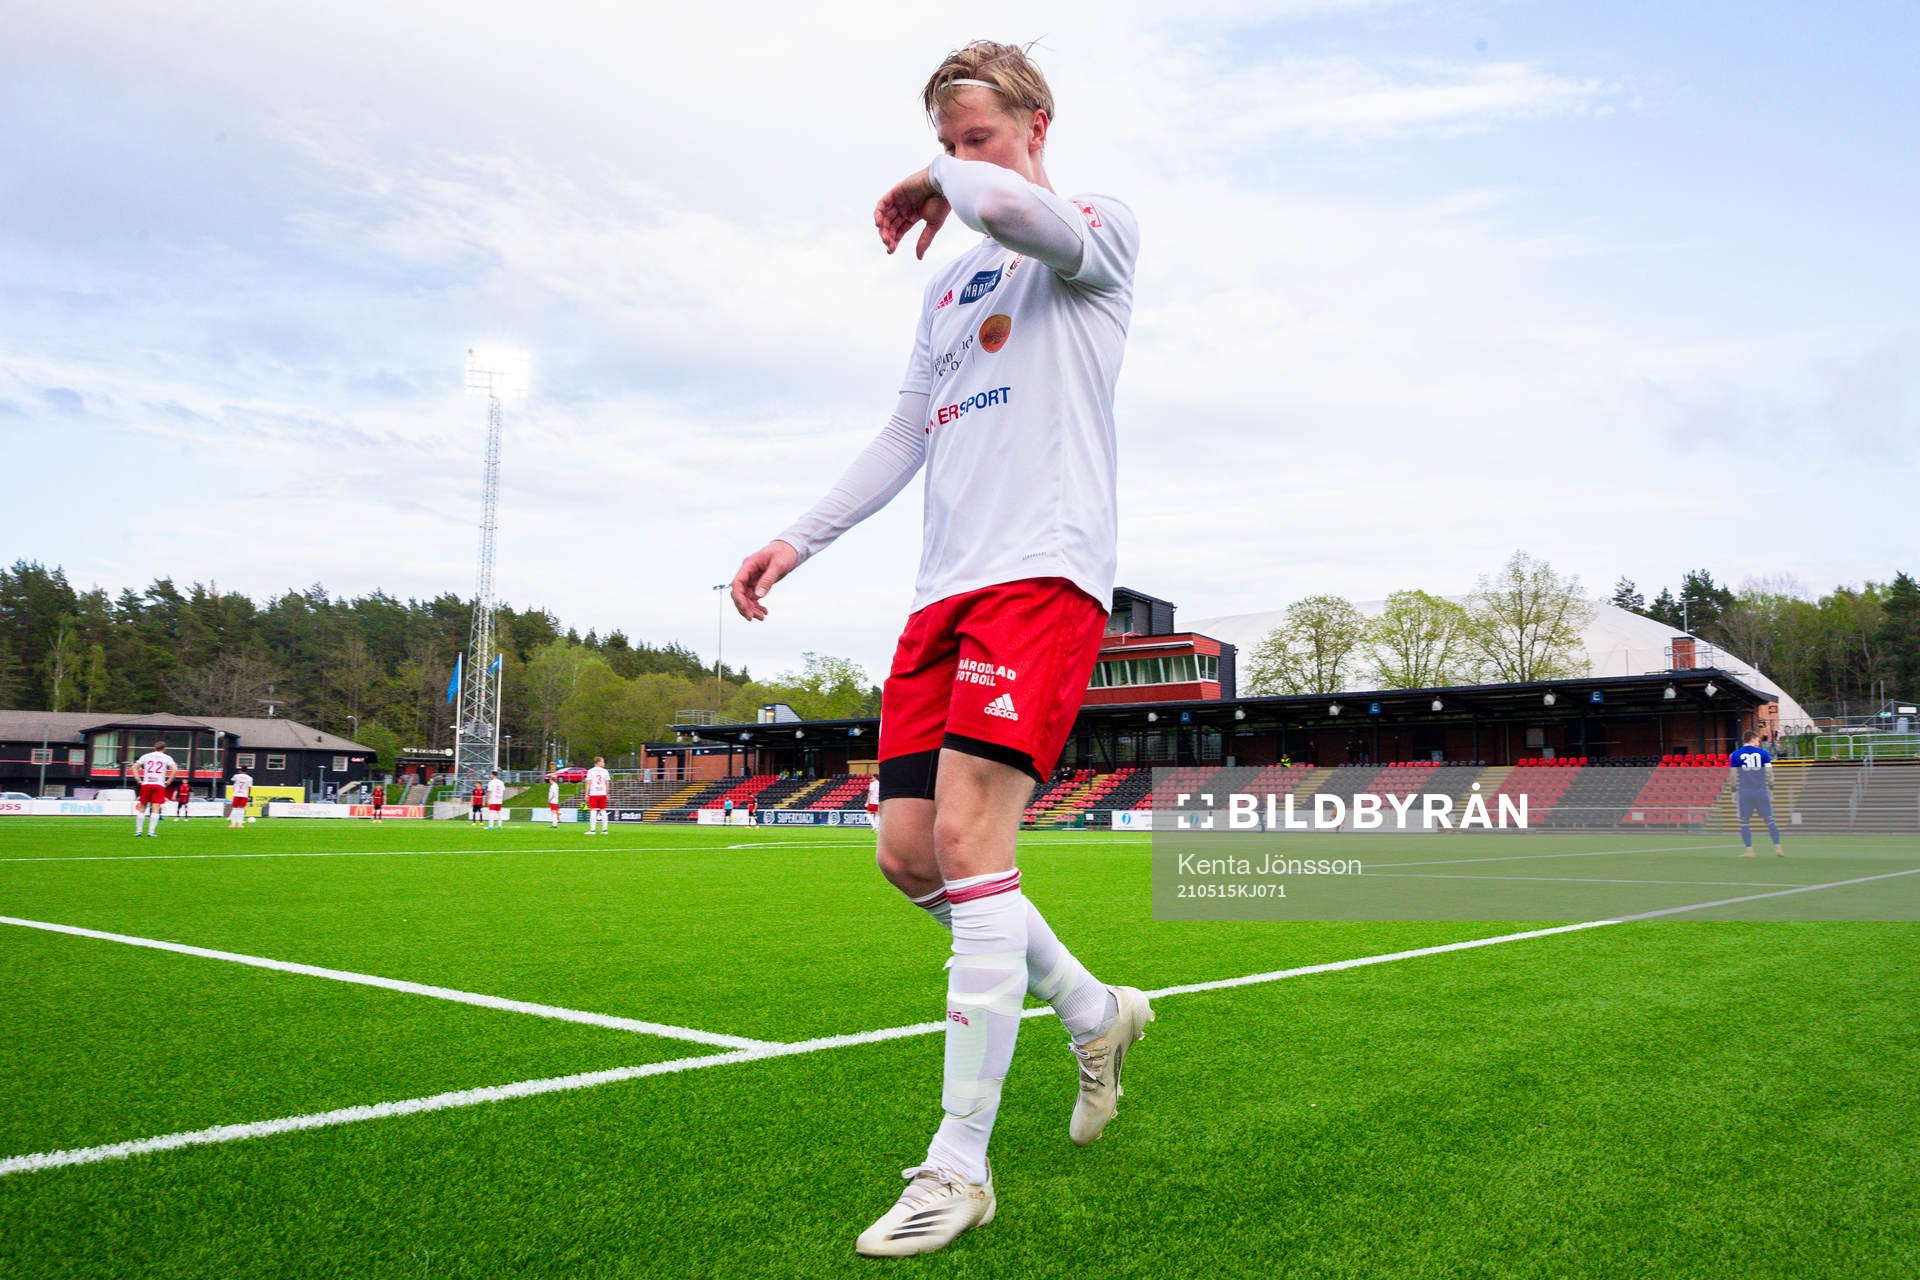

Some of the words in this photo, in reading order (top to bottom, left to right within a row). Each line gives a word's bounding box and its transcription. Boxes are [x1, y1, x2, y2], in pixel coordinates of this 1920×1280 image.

[926, 387, 1011, 435] ERSPORT
[984, 706, 1019, 721] adidas
[147, 760, 163, 773] 22
[1740, 753, 1762, 771] 30
